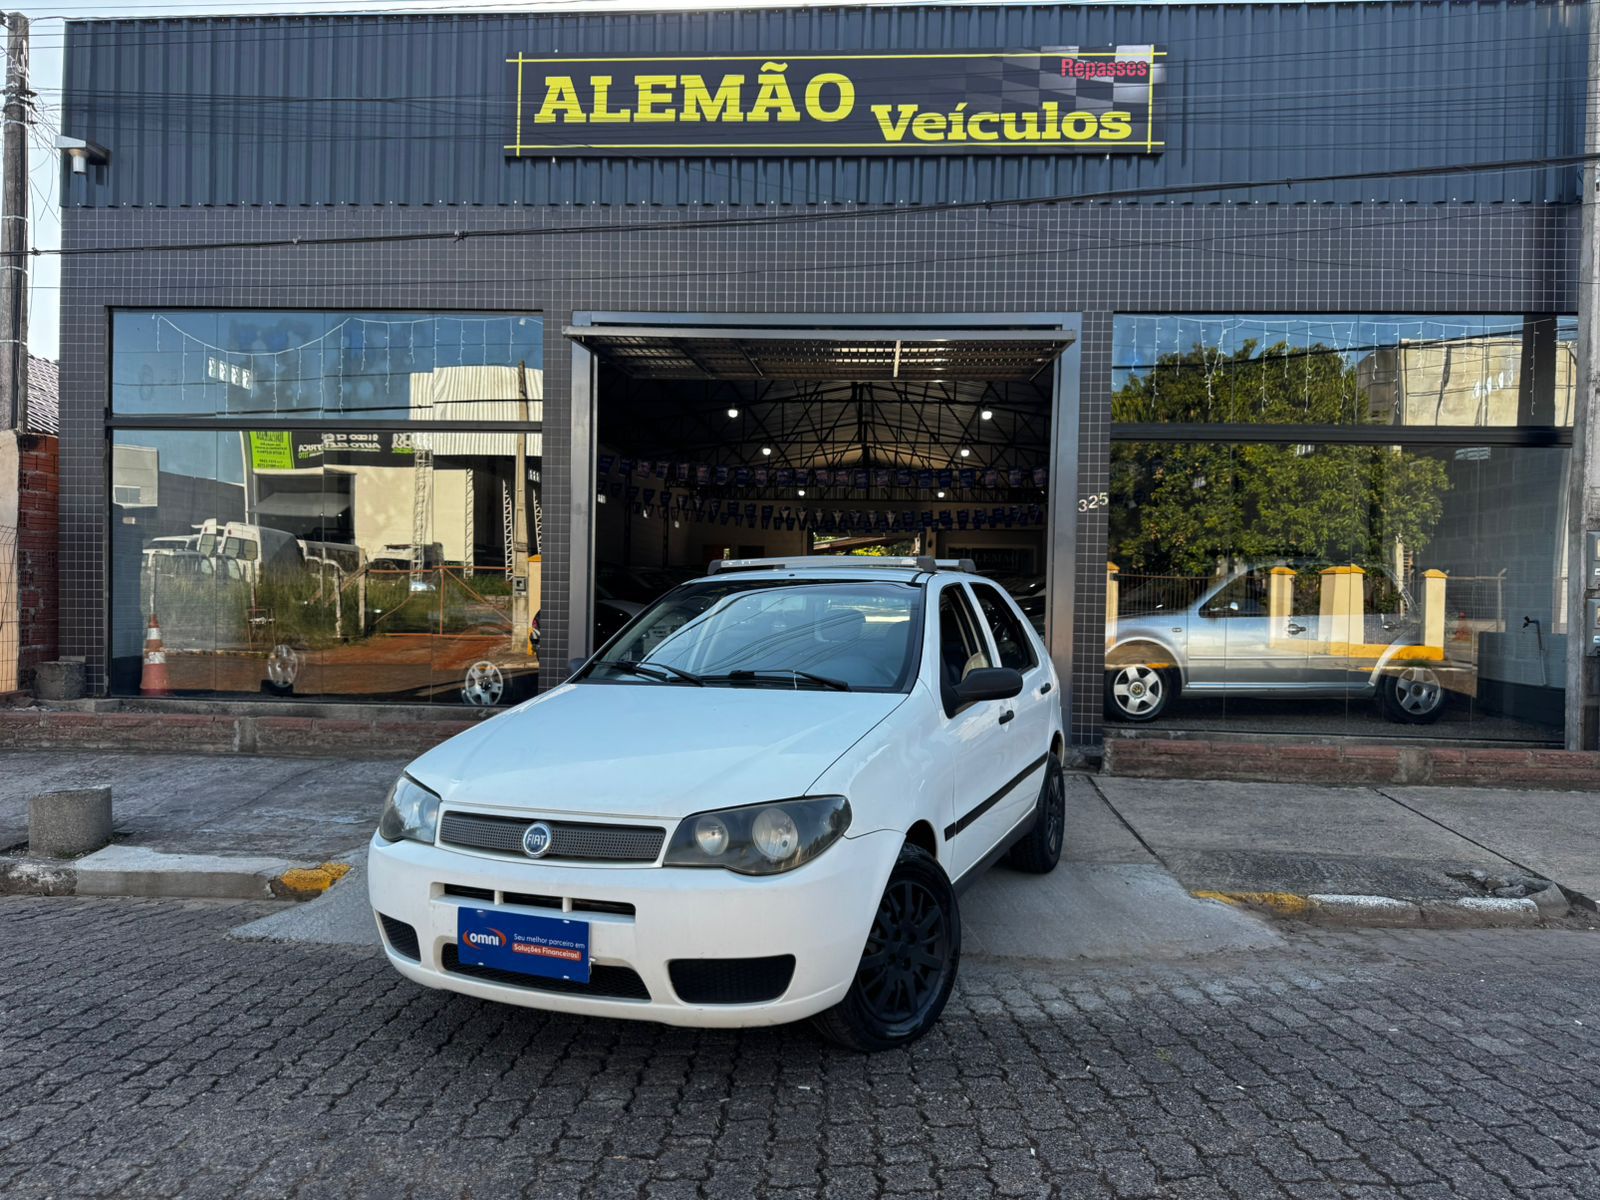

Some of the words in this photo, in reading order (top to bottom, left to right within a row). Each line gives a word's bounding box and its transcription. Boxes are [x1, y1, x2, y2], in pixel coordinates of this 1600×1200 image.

[1061, 58, 1148, 80] Repasses
[534, 61, 855, 123] ALEMÃO
[870, 101, 1132, 141] Veículos
[1078, 492, 1109, 512] 325
[526, 833, 547, 846] FIAT
[469, 932, 500, 946] omni
[513, 933, 526, 941] Seu
[526, 935, 548, 944] melhor
[549, 938, 574, 949] parceiro
[513, 943, 542, 954] Soluções
[542, 947, 581, 959] Financeiras!
